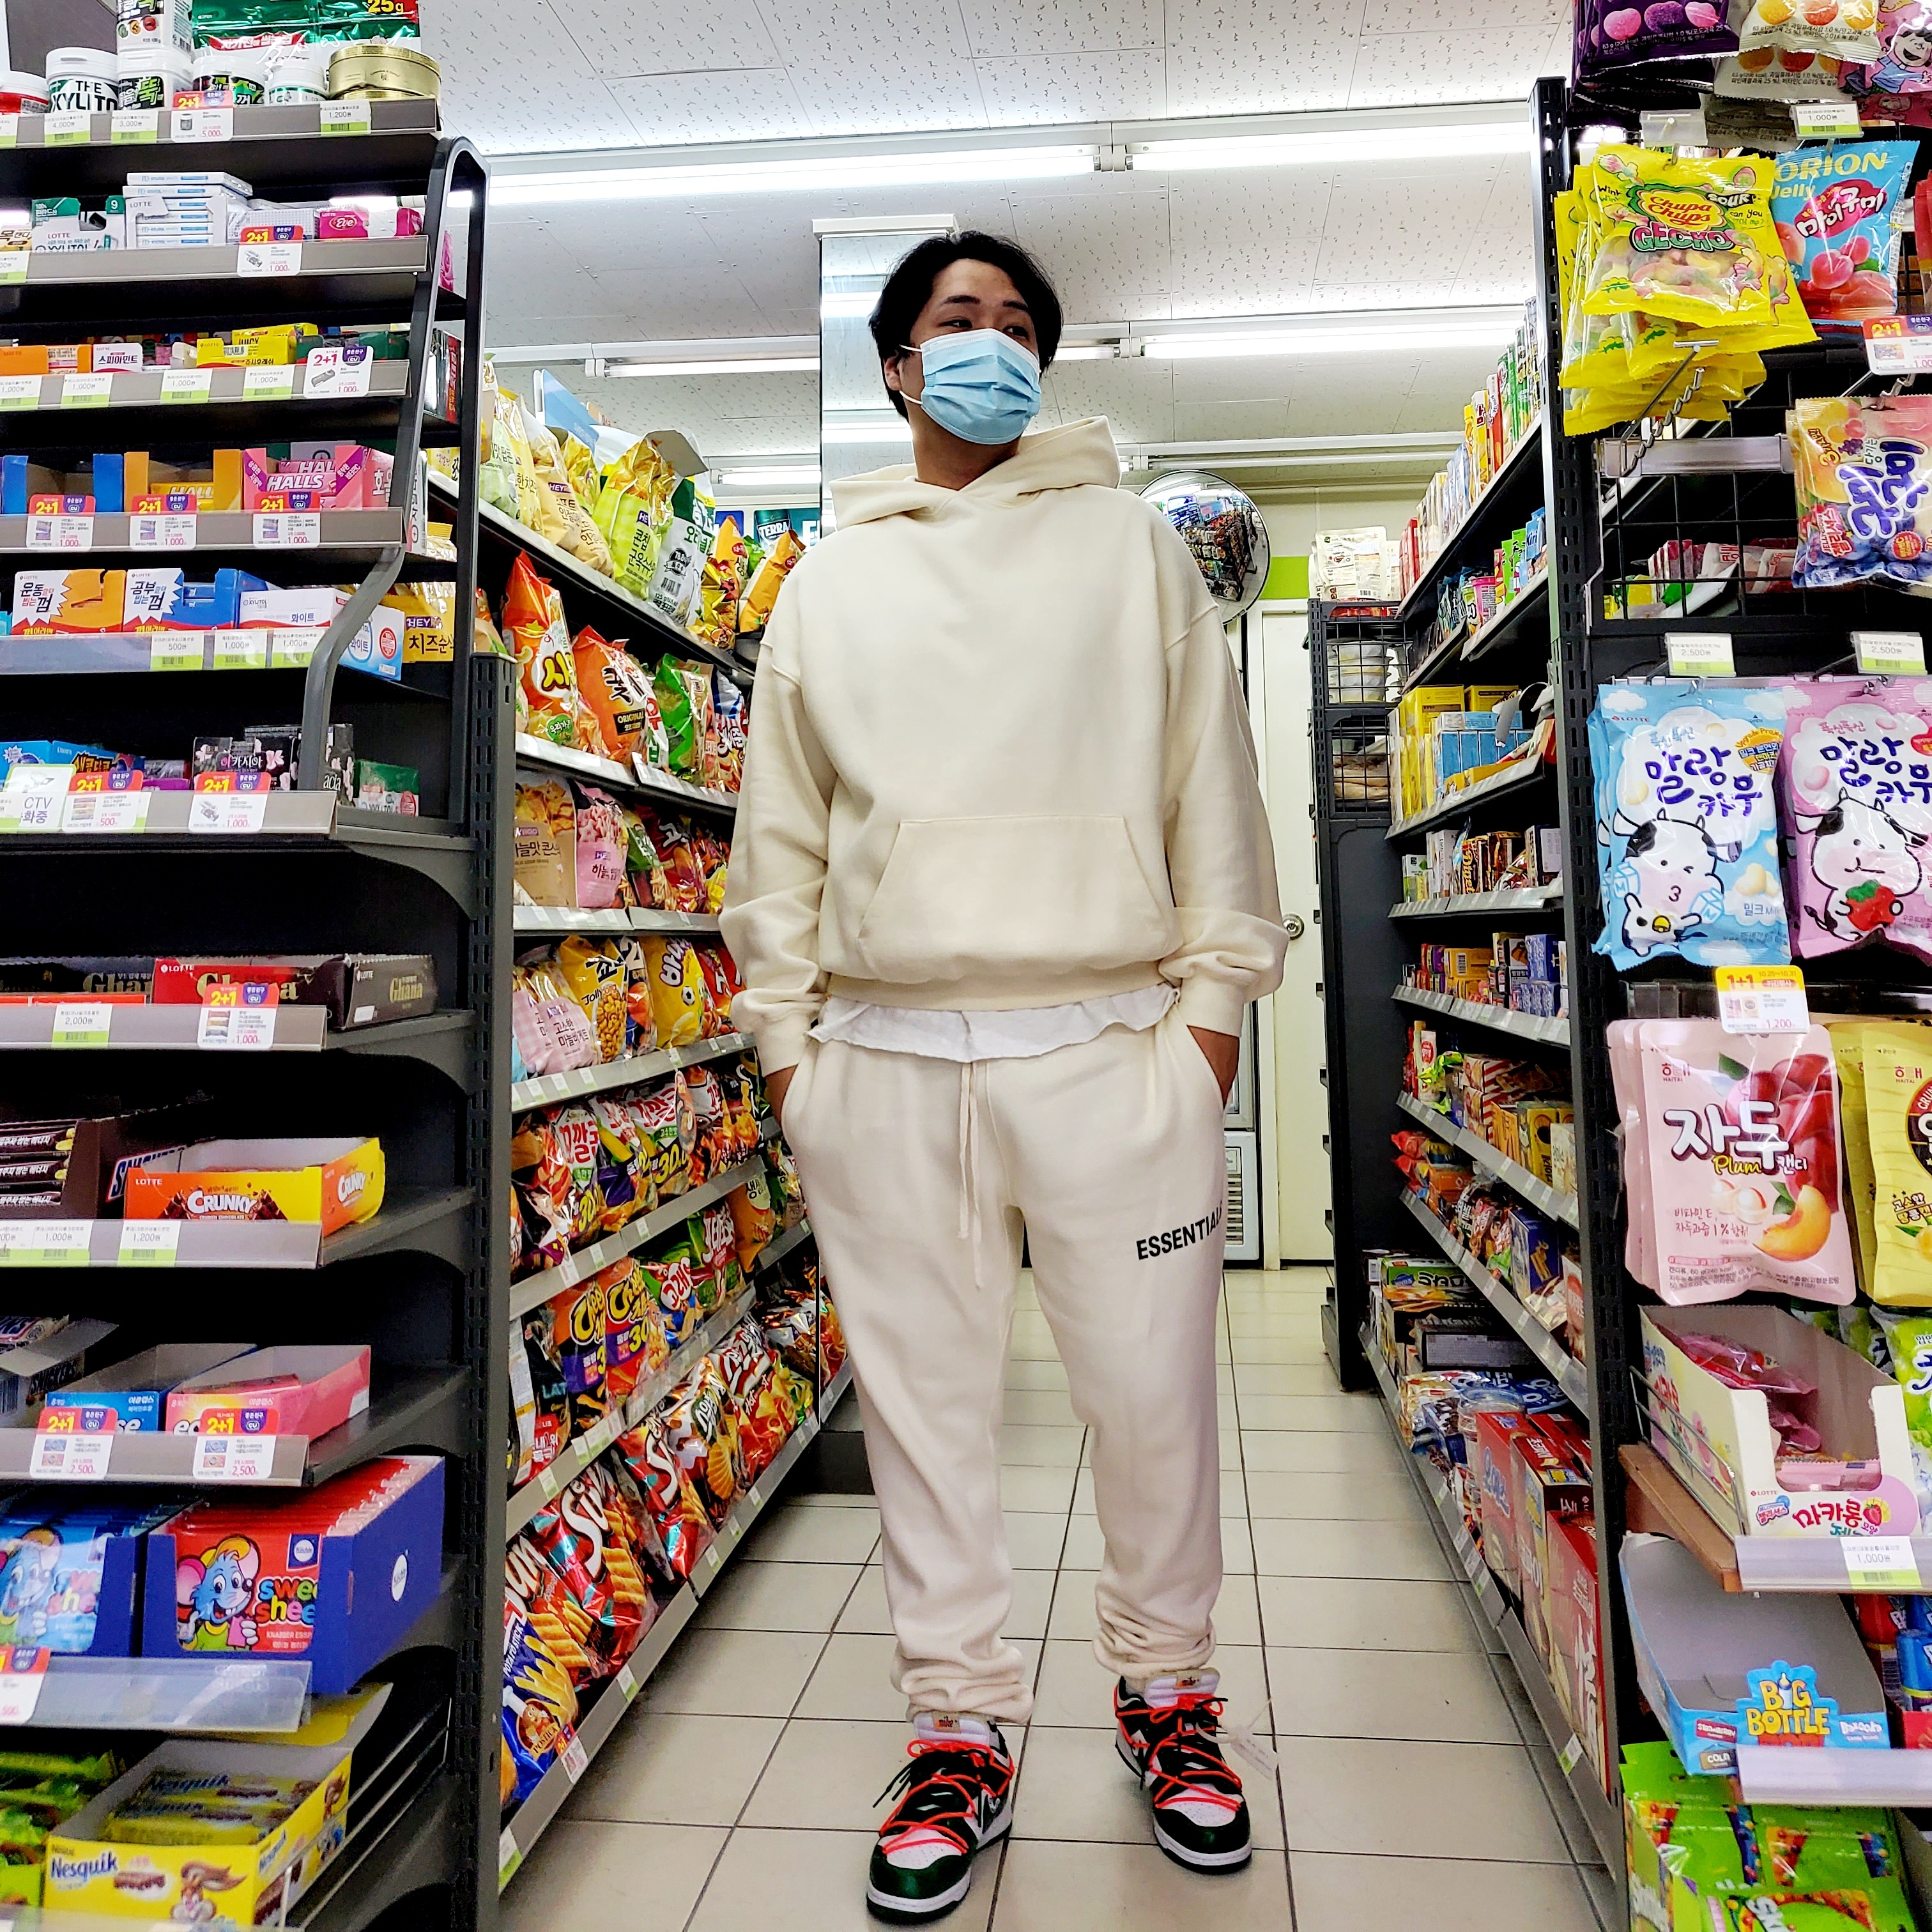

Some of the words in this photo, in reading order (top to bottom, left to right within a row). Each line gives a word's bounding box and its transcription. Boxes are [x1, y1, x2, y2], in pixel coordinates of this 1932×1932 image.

[75, 80, 102, 94] THE
[1774, 153, 1887, 178] ORION
[1598, 185, 1623, 196] Wink
[111, 200, 118, 209] 9
[1650, 197, 1712, 215] Chupa
[1709, 192, 1753, 207] SOUR
[1650, 204, 1712, 225] Chups
[1747, 210, 1763, 220] you
[1797, 187, 1883, 237] 마이구미
[336, 217, 354, 227] Eve
[246, 231, 269, 243] 2+1
[1871, 321, 1903, 337] 2+1
[98, 355, 138, 365] 스피아민트
[313, 354, 337, 366] 2+1
[267, 475, 323, 491] HALLS
[170, 486, 213, 498] HALL
[35, 502, 58, 515] 2+1
[139, 501, 161, 514] 2+1
[261, 498, 284, 512] 2+1
[759, 521, 789, 537] TERRA
[20, 582, 43, 597] 운동
[130, 581, 155, 595] 공부
[37, 597, 51, 613] 껌
[149, 594, 164, 611] 껌
[291, 613, 314, 623] 화이트
[220, 755, 263, 768] 아카시아
[1820, 736, 1904, 788] 말랑
[1644, 746, 1732, 804] 말랑
[77, 779, 102, 793] 2+1
[204, 779, 229, 793] 2+1
[1697, 774, 1763, 817] 카우
[20, 811, 49, 824] 화중
[1744, 902, 1764, 916] 밀크
[169, 964, 195, 972] LOTTE
[1726, 974, 1755, 990] 1+1
[210, 991, 236, 1007] 2+1
[390, 979, 422, 1004] Ghana
[581, 989, 602, 1006] Jolly
[1664, 1100, 1789, 1174] 자두
[1712, 1155, 1763, 1176] Plum
[1777, 1154, 1808, 1175] 캔디
[338, 1172, 367, 1201] CRUNKY
[187, 1190, 257, 1215] CRUNKY
[1675, 1208, 1703, 1220] 비타민
[1137, 1199, 1222, 1261] ESSENTIAL
[47, 1417, 73, 1433] 2+1
[207, 1418, 234, 1434] 2+1
[1792, 1498, 1864, 1529] 마카롱
[1861, 1522, 1880, 1535] 모양
[1856, 1553, 1891, 1563] 1,000원
[1745, 1707, 1830, 1736] BOTTLE
[531, 1721, 560, 1757] POSTICK
[1706, 1752, 1730, 1764] COLA
[51, 1851, 119, 1883] Nesquik
